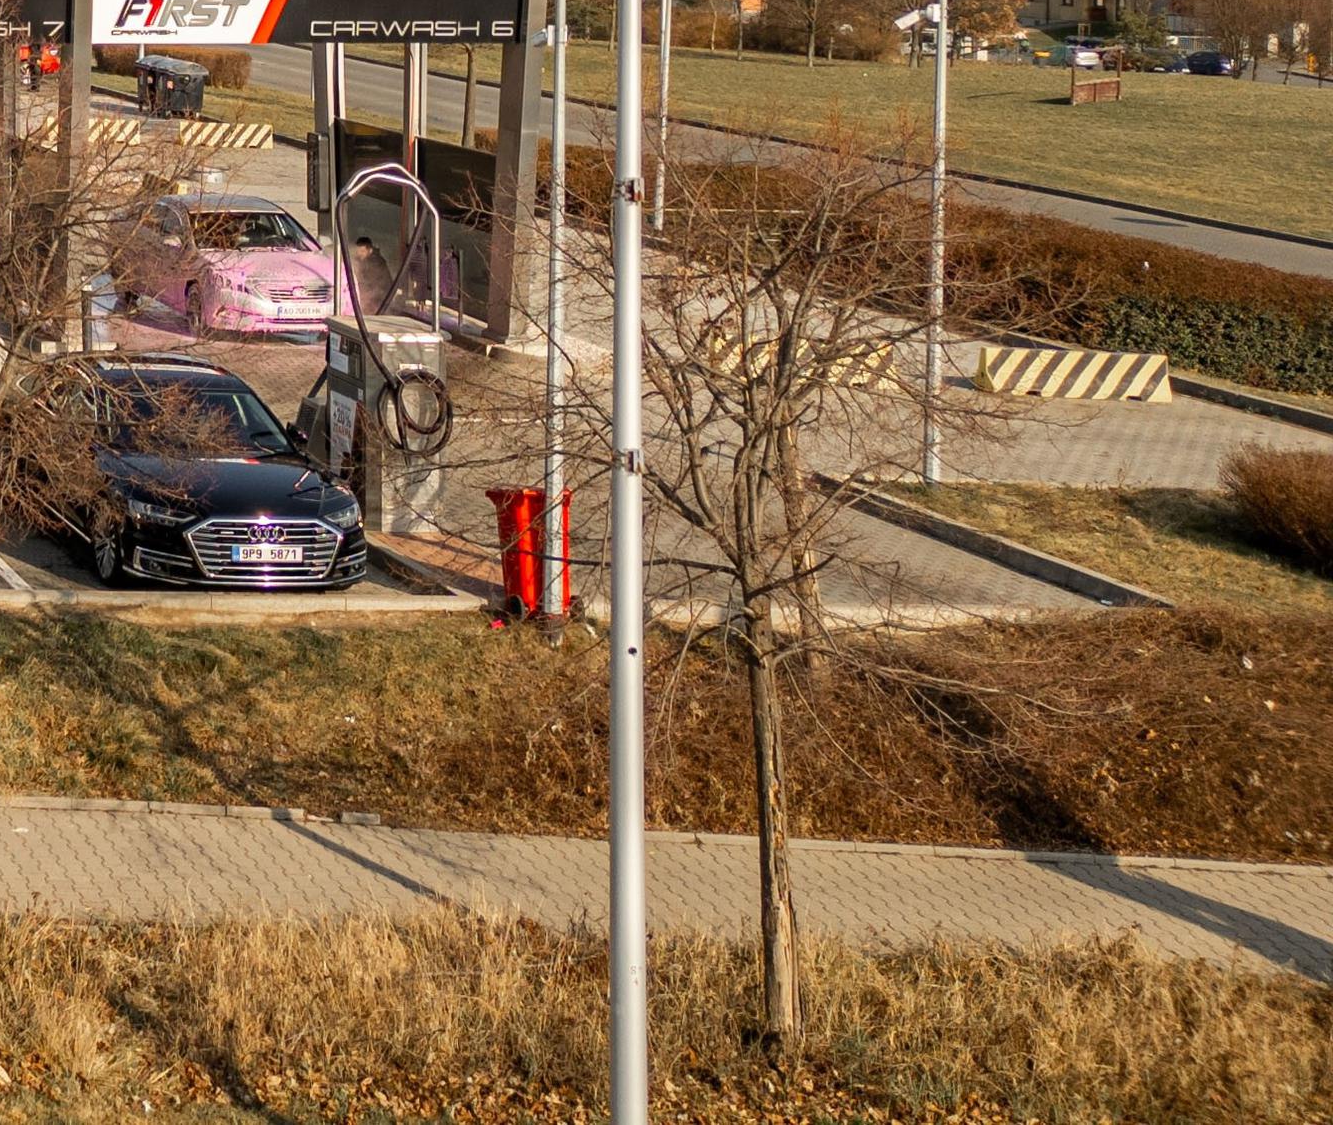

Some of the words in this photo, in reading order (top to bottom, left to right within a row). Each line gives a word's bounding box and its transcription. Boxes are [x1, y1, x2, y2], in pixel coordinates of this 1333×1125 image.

[43, 21, 65, 37] 7
[310, 20, 480, 37] CARWASH
[492, 20, 514, 37] 6
[242, 548, 263, 560] 9P9
[270, 548, 297, 560] 5871
